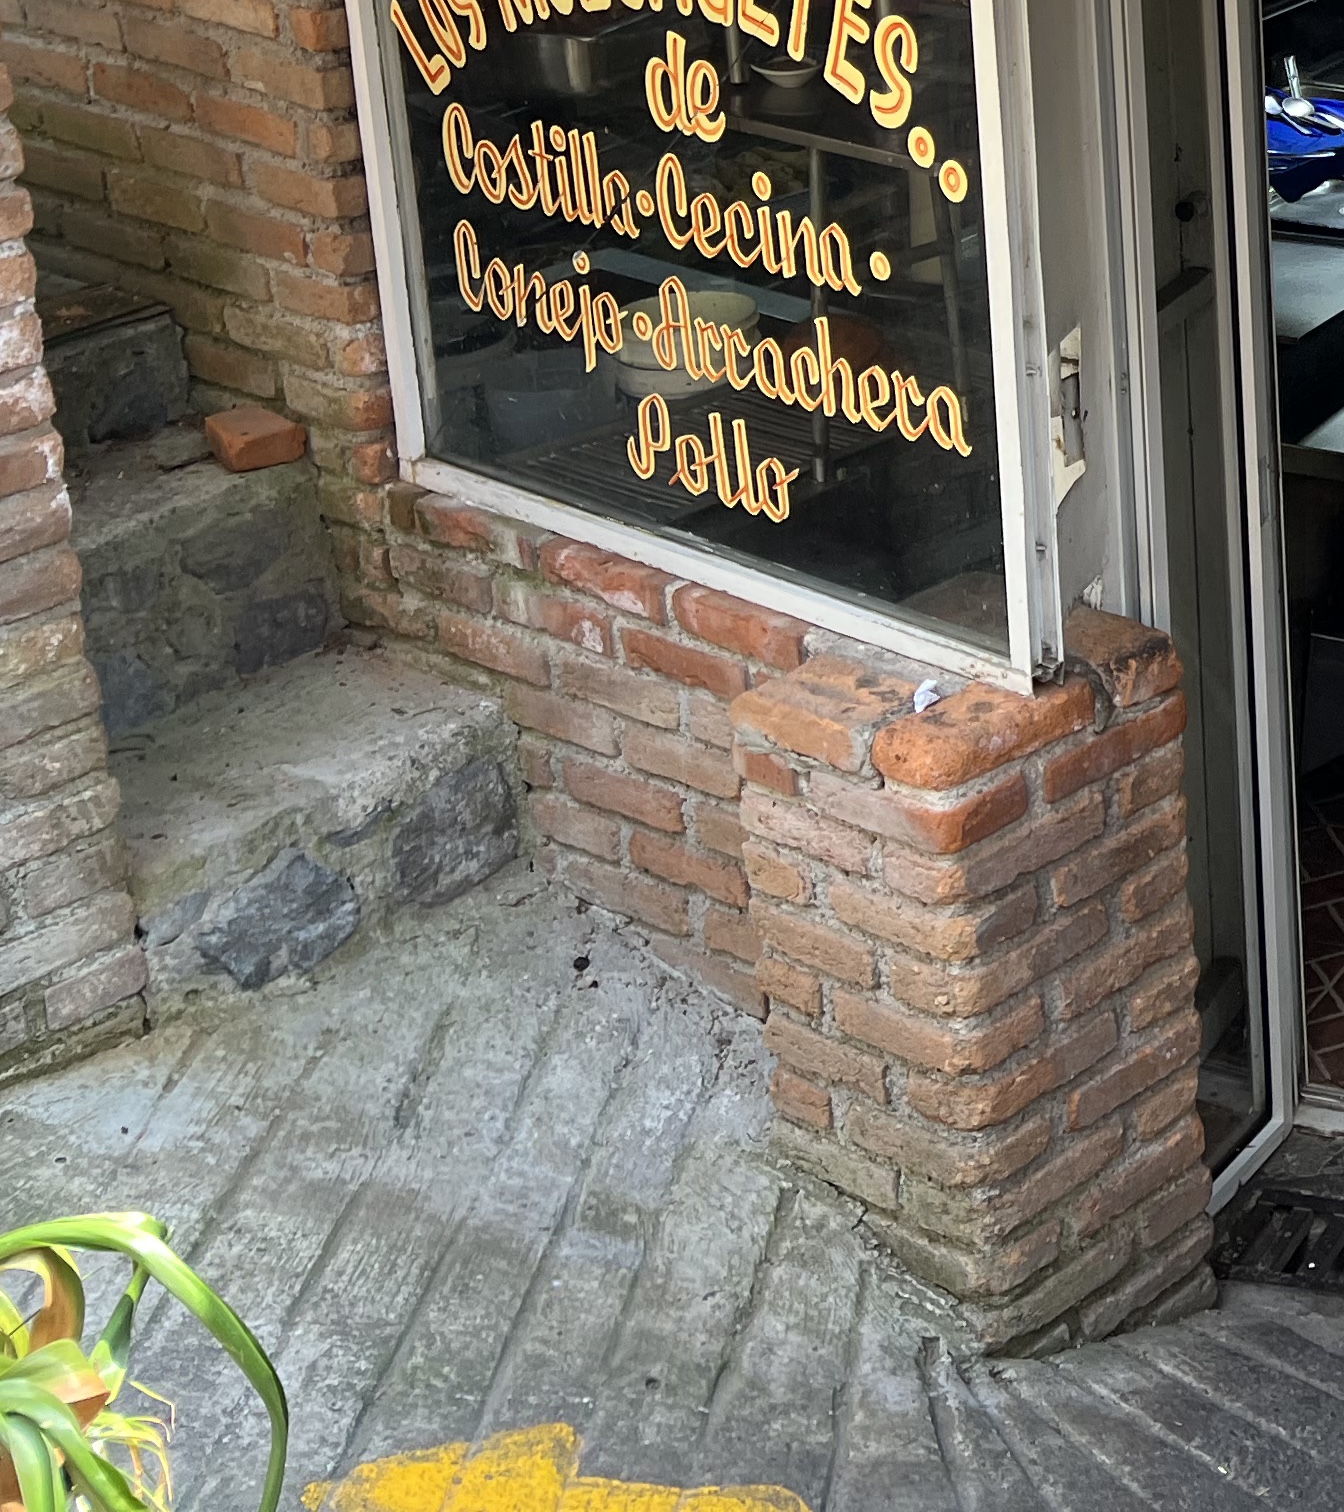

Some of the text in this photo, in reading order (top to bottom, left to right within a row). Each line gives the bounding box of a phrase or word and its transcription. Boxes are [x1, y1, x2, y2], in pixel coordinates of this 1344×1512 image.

[645, 31, 727, 142] de
[442, 102, 640, 239] Costilla
[452, 219, 973, 458] Conejo Arrachera
[627, 393, 820, 523] Pollo
